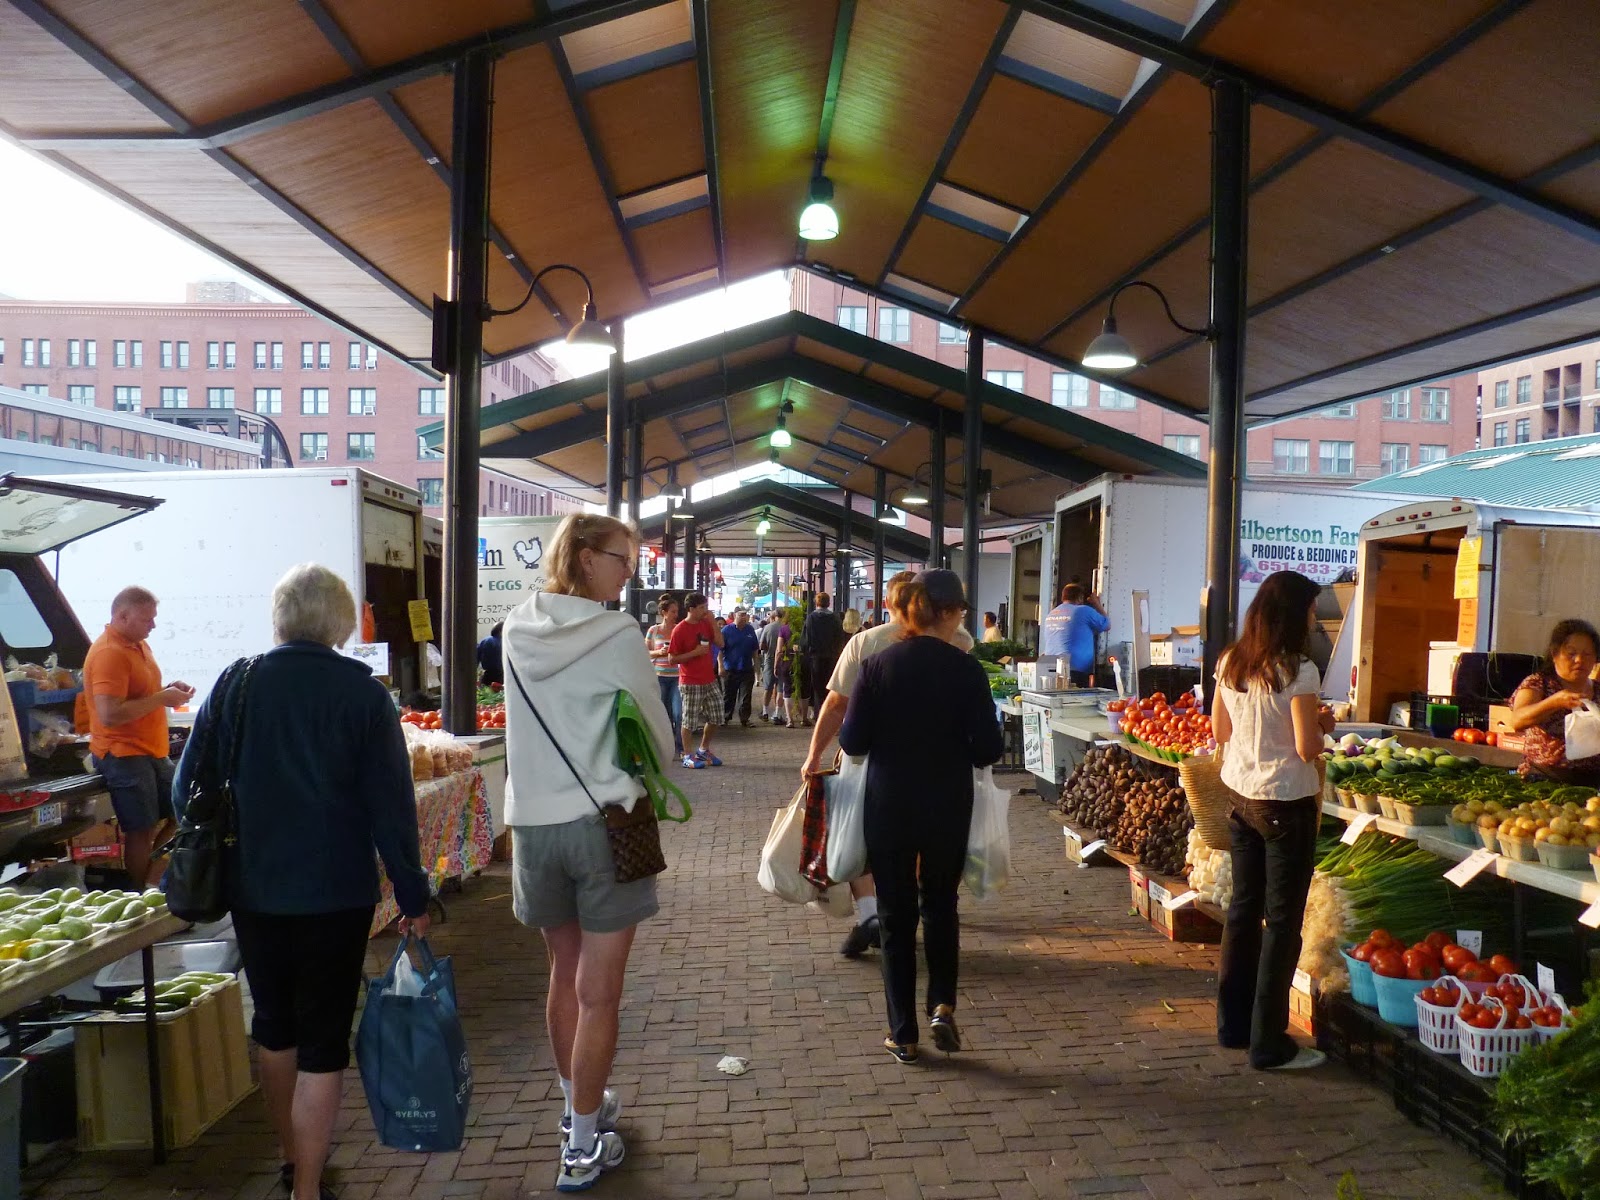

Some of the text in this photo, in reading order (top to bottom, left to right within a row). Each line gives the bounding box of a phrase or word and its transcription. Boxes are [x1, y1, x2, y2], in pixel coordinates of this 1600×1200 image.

[1240, 519, 1359, 546] ilbertson Far
[1251, 543, 1296, 561] PRODUCE
[1298, 548, 1305, 561] &
[1307, 547, 1348, 564] BEDDING
[488, 580, 522, 591] EGGS
